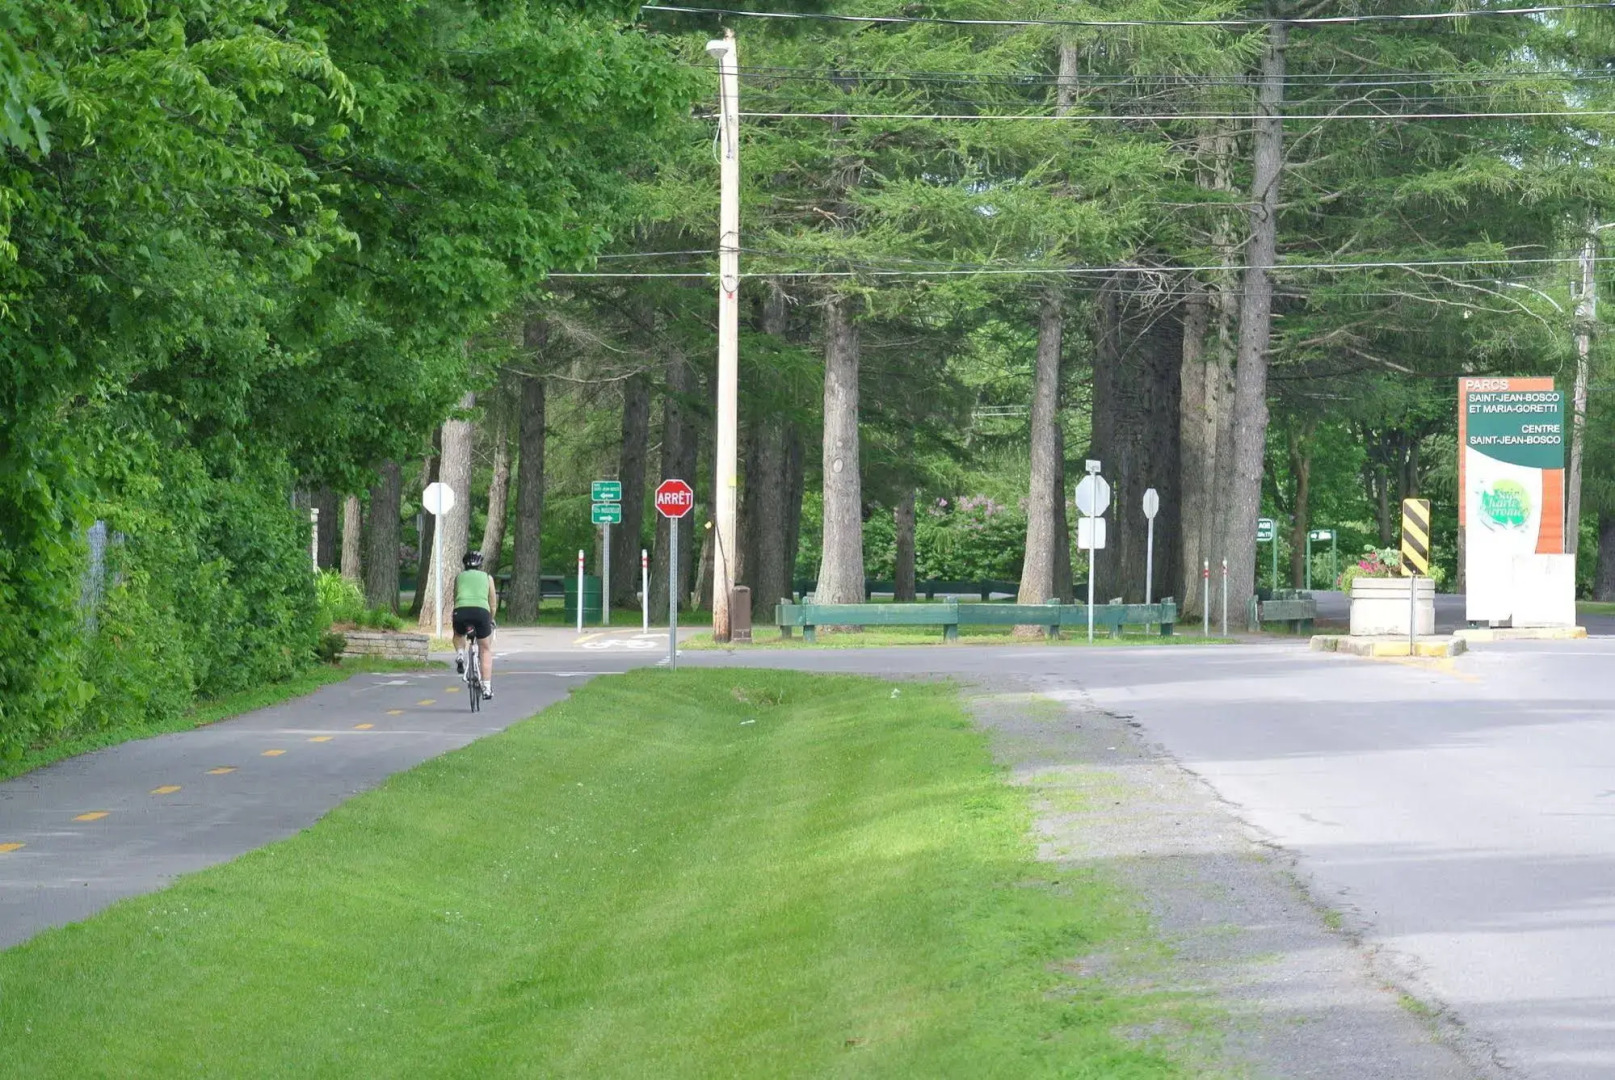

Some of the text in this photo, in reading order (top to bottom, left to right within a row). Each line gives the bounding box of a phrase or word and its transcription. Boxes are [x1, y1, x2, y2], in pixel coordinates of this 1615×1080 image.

[1465, 379, 1509, 390] PARCS
[1469, 393, 1559, 402] SAINT-JEAN-BOSCO
[1469, 404, 1557, 413] ET MARIA-GORETTI
[1521, 424, 1560, 433] CENTRE
[1470, 435, 1560, 444] SAINT-JEAN-BOSCO
[657, 490, 691, 505] ARRÊT
